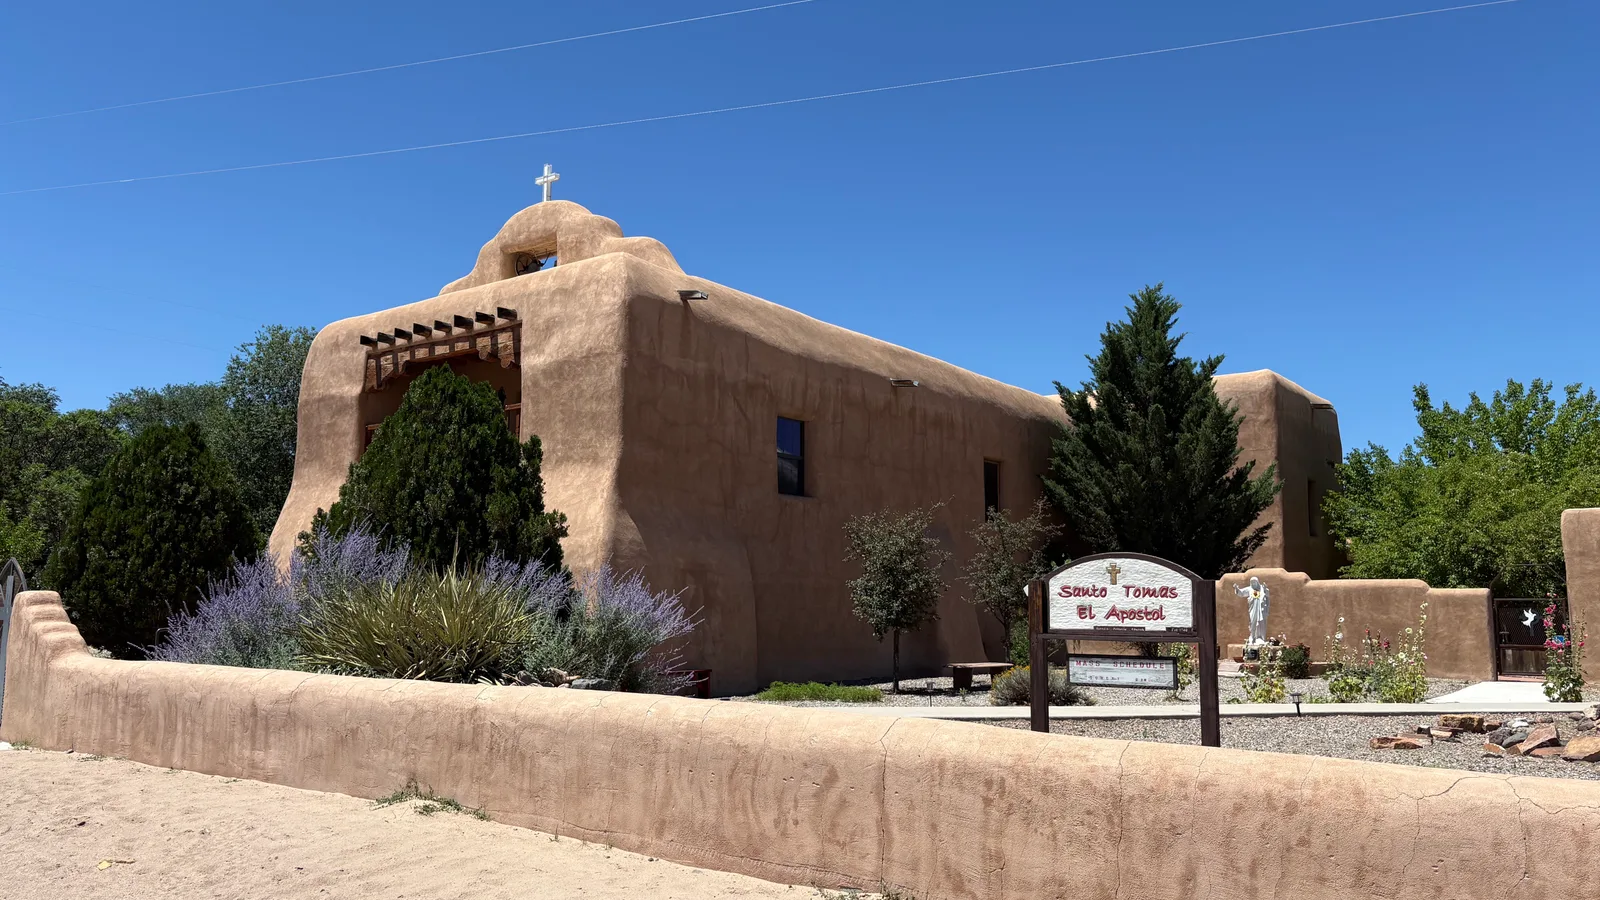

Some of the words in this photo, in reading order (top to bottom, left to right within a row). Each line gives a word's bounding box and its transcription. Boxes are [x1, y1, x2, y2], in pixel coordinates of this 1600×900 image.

[1057, 584, 1108, 598] Santo
[1121, 584, 1179, 599] Tomas
[1076, 604, 1096, 620] El
[1103, 604, 1167, 623] Apostol
[1113, 661, 1165, 669] SCHEDULE
